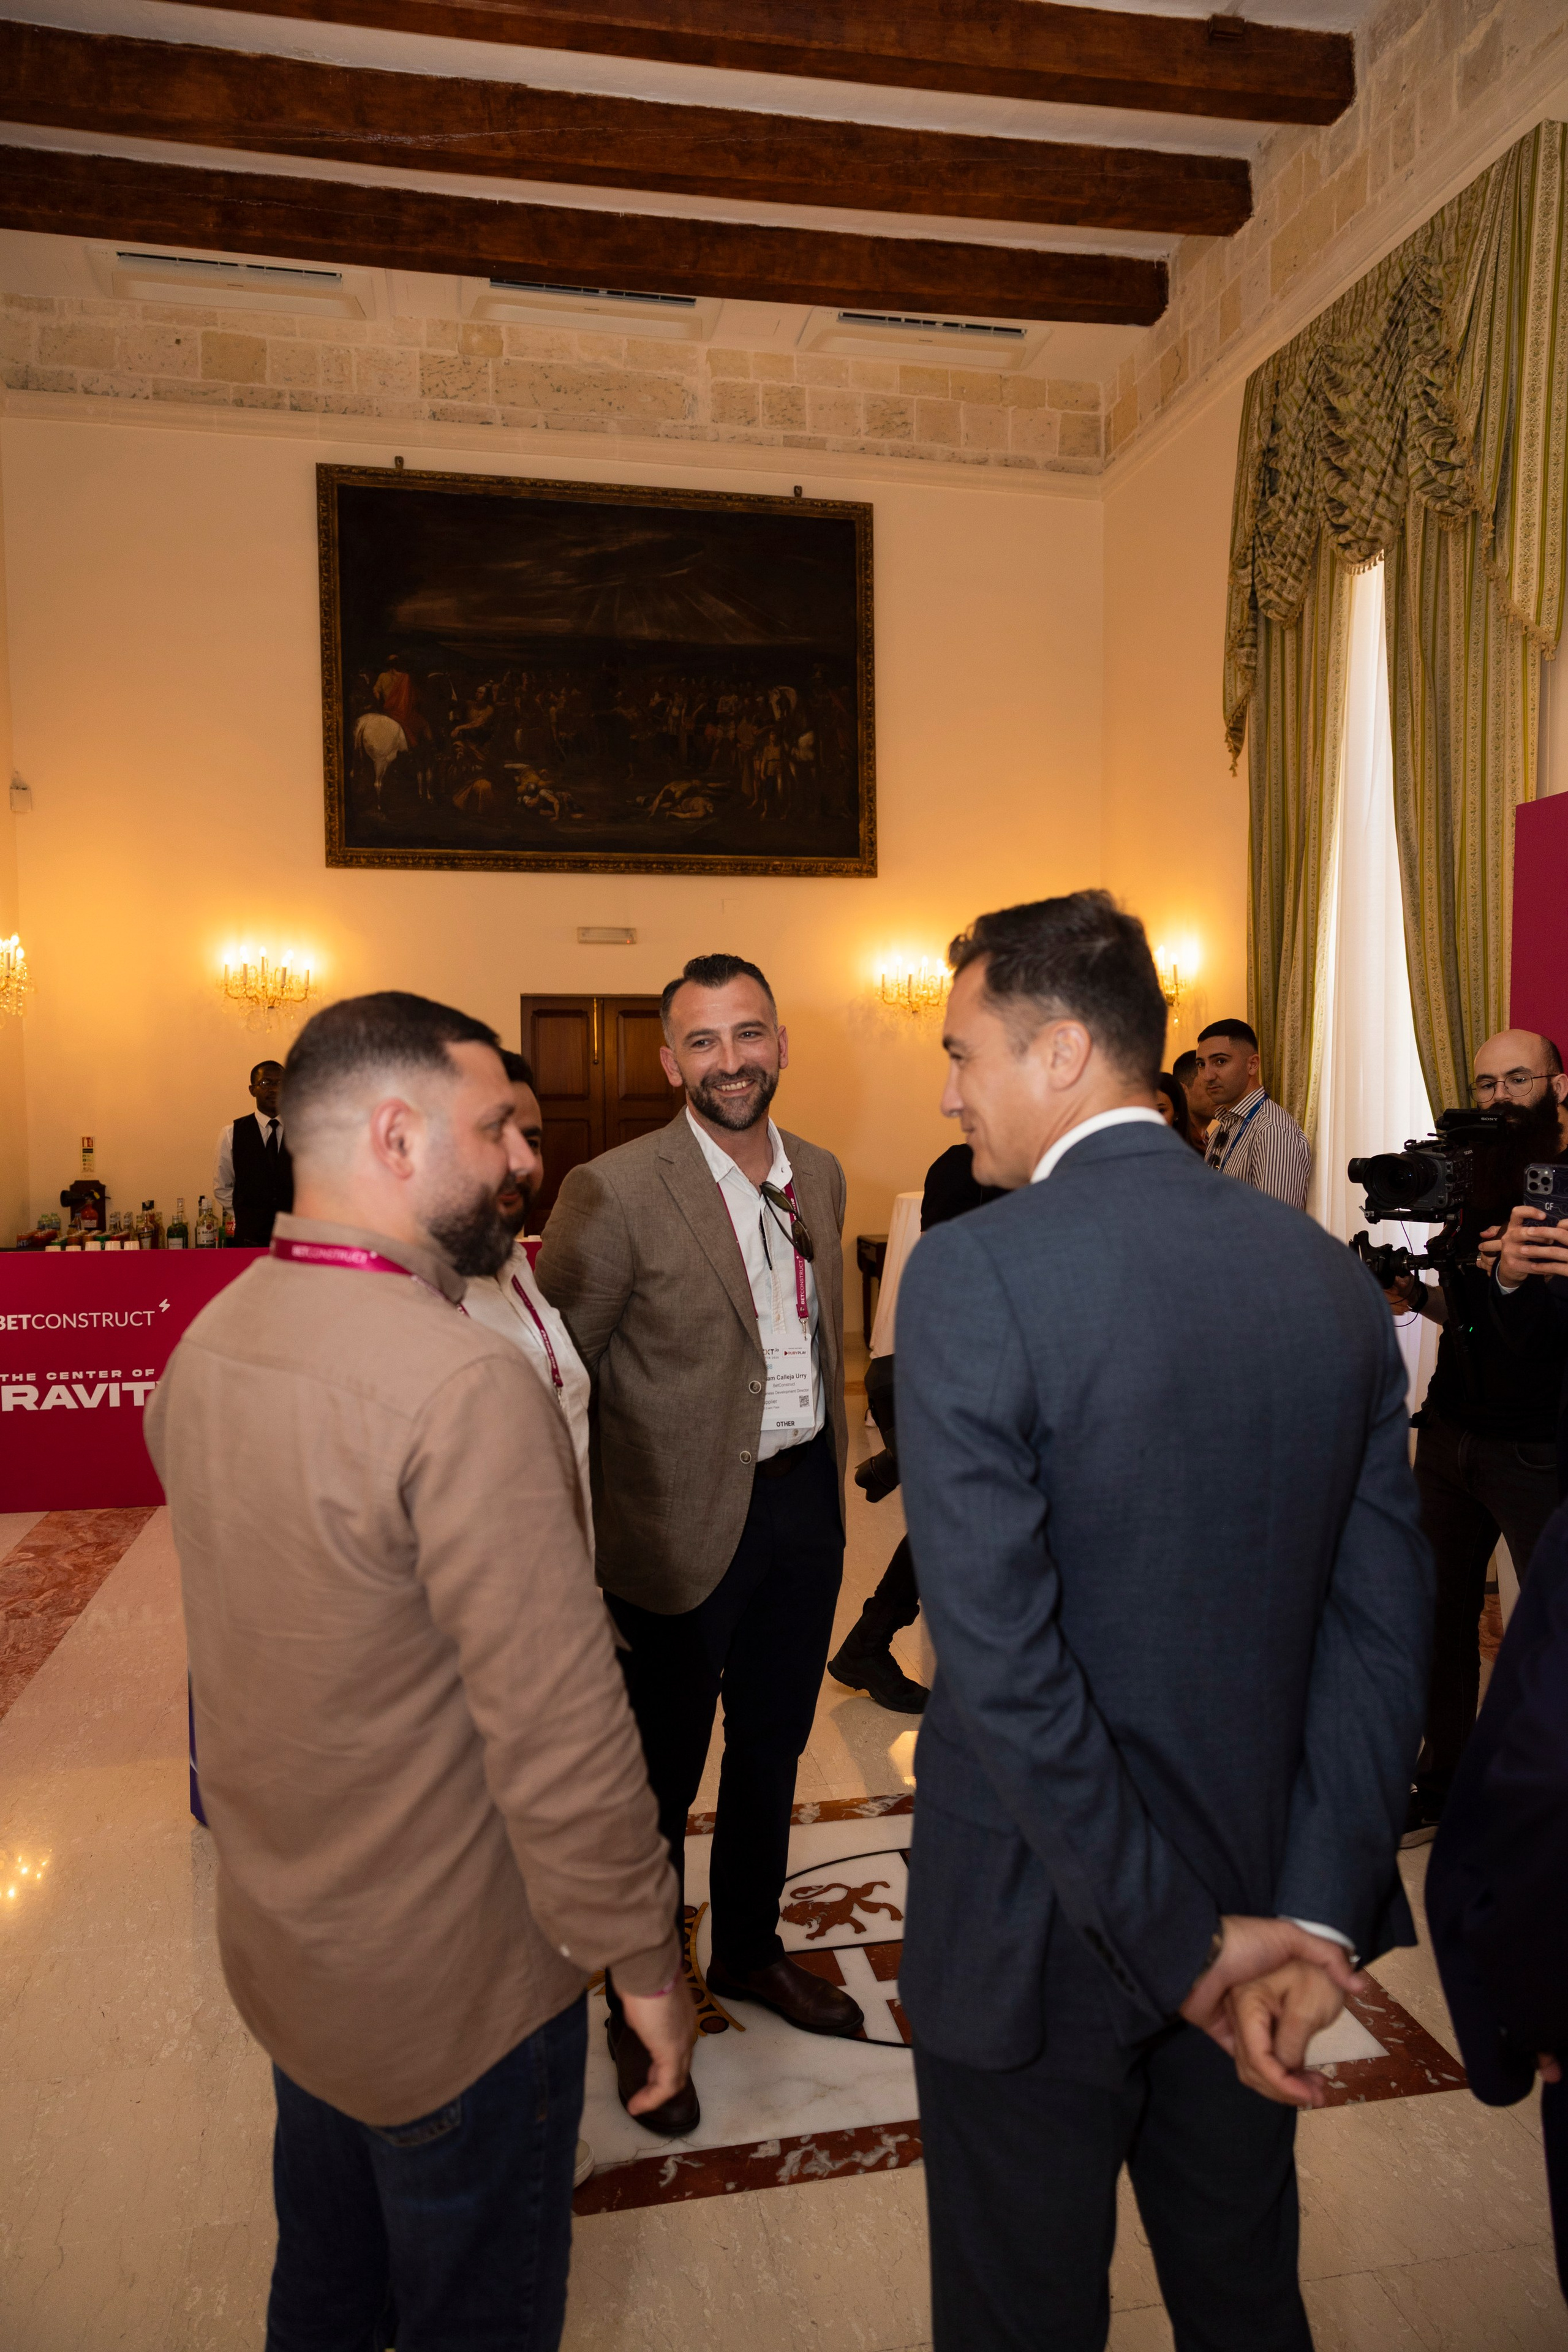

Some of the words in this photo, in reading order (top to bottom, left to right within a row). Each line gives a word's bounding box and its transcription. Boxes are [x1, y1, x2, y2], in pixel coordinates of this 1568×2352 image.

[0, 1373, 36, 1381] THE
[46, 1370, 122, 1380] CENTER
[132, 1368, 155, 1377] OF
[1, 1381, 160, 1411] RAVIT
